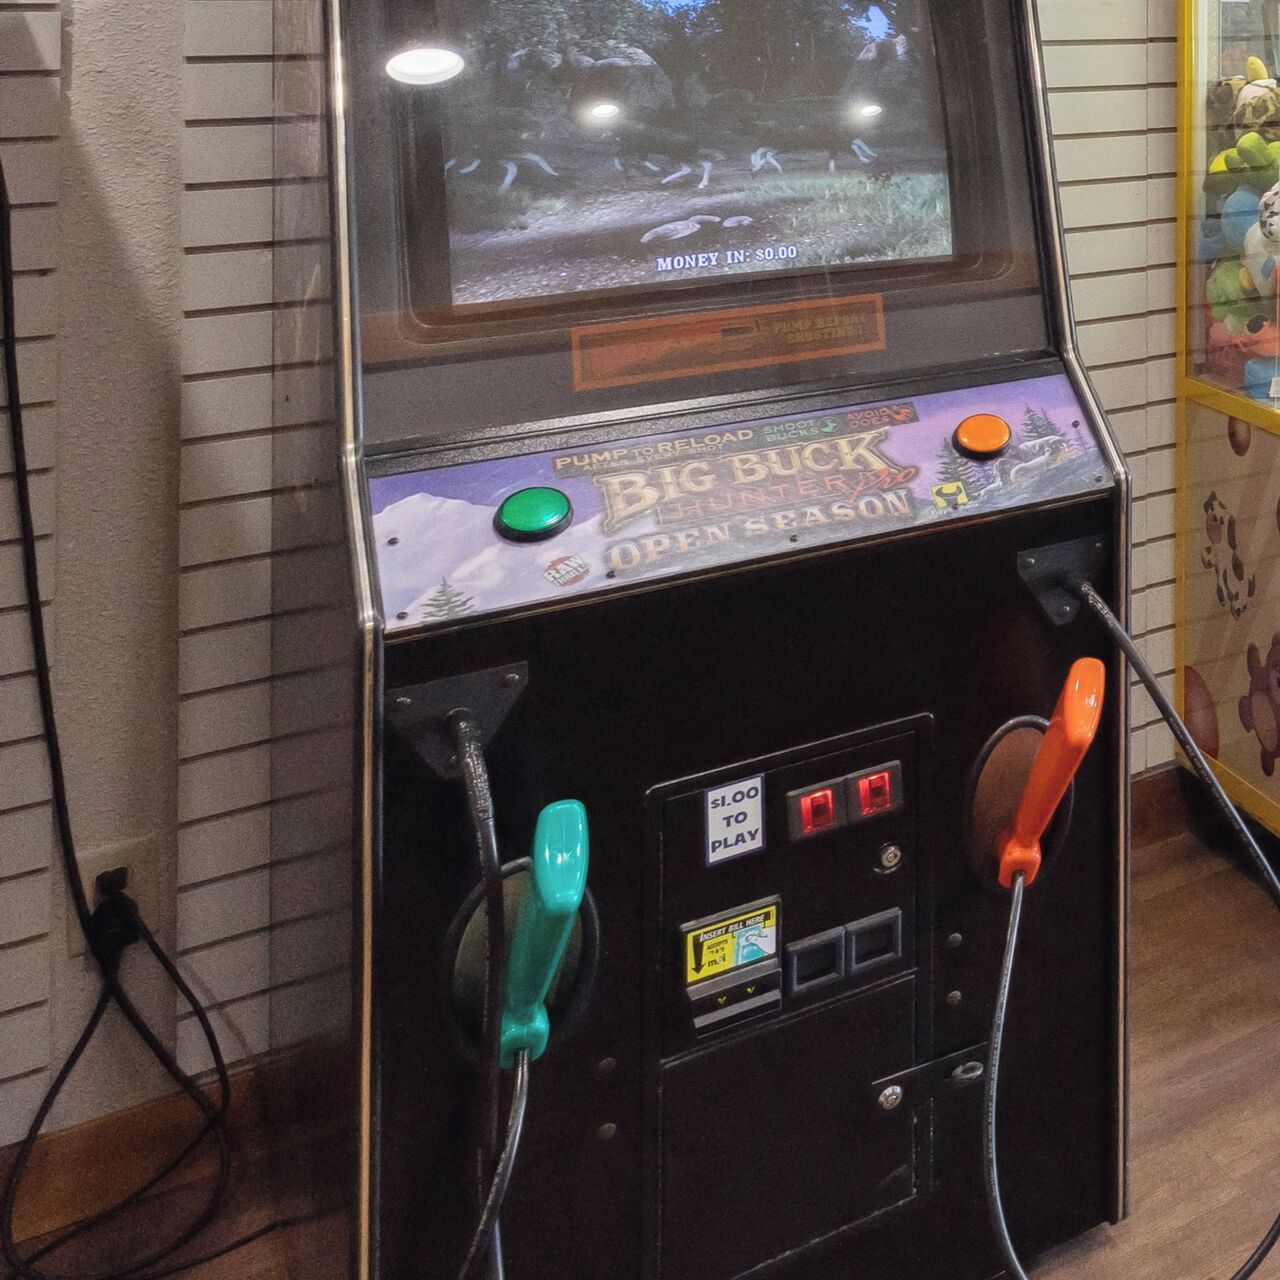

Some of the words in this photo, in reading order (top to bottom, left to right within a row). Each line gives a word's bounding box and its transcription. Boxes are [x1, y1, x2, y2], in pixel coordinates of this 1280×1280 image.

[656, 252, 719, 271] MONEY
[726, 249, 750, 264] IN:
[755, 245, 797, 261] $0.00
[763, 419, 817, 434] SHOOT
[846, 408, 889, 421] AVOID
[849, 415, 889, 428] DOES
[766, 427, 820, 442] BUCKS
[555, 448, 628, 470] PUMP
[631, 446, 654, 458] TO
[657, 429, 753, 453] RELOAD
[688, 443, 724, 455] SHOT
[599, 461, 717, 531] BIG
[731, 430, 898, 485] BUCK
[851, 465, 918, 504] Pro
[673, 471, 847, 519] HUNTER
[607, 522, 731, 572] OPEN
[743, 488, 912, 536] SEASON
[544, 554, 586, 583] RAW
[710, 785, 760, 809] $1.00
[722, 811, 749, 829] TO
[710, 828, 760, 854] PLAY
[700, 926, 727, 942] INSERT
[728, 921, 744, 933] BILL
[745, 914, 765, 926] HERE
